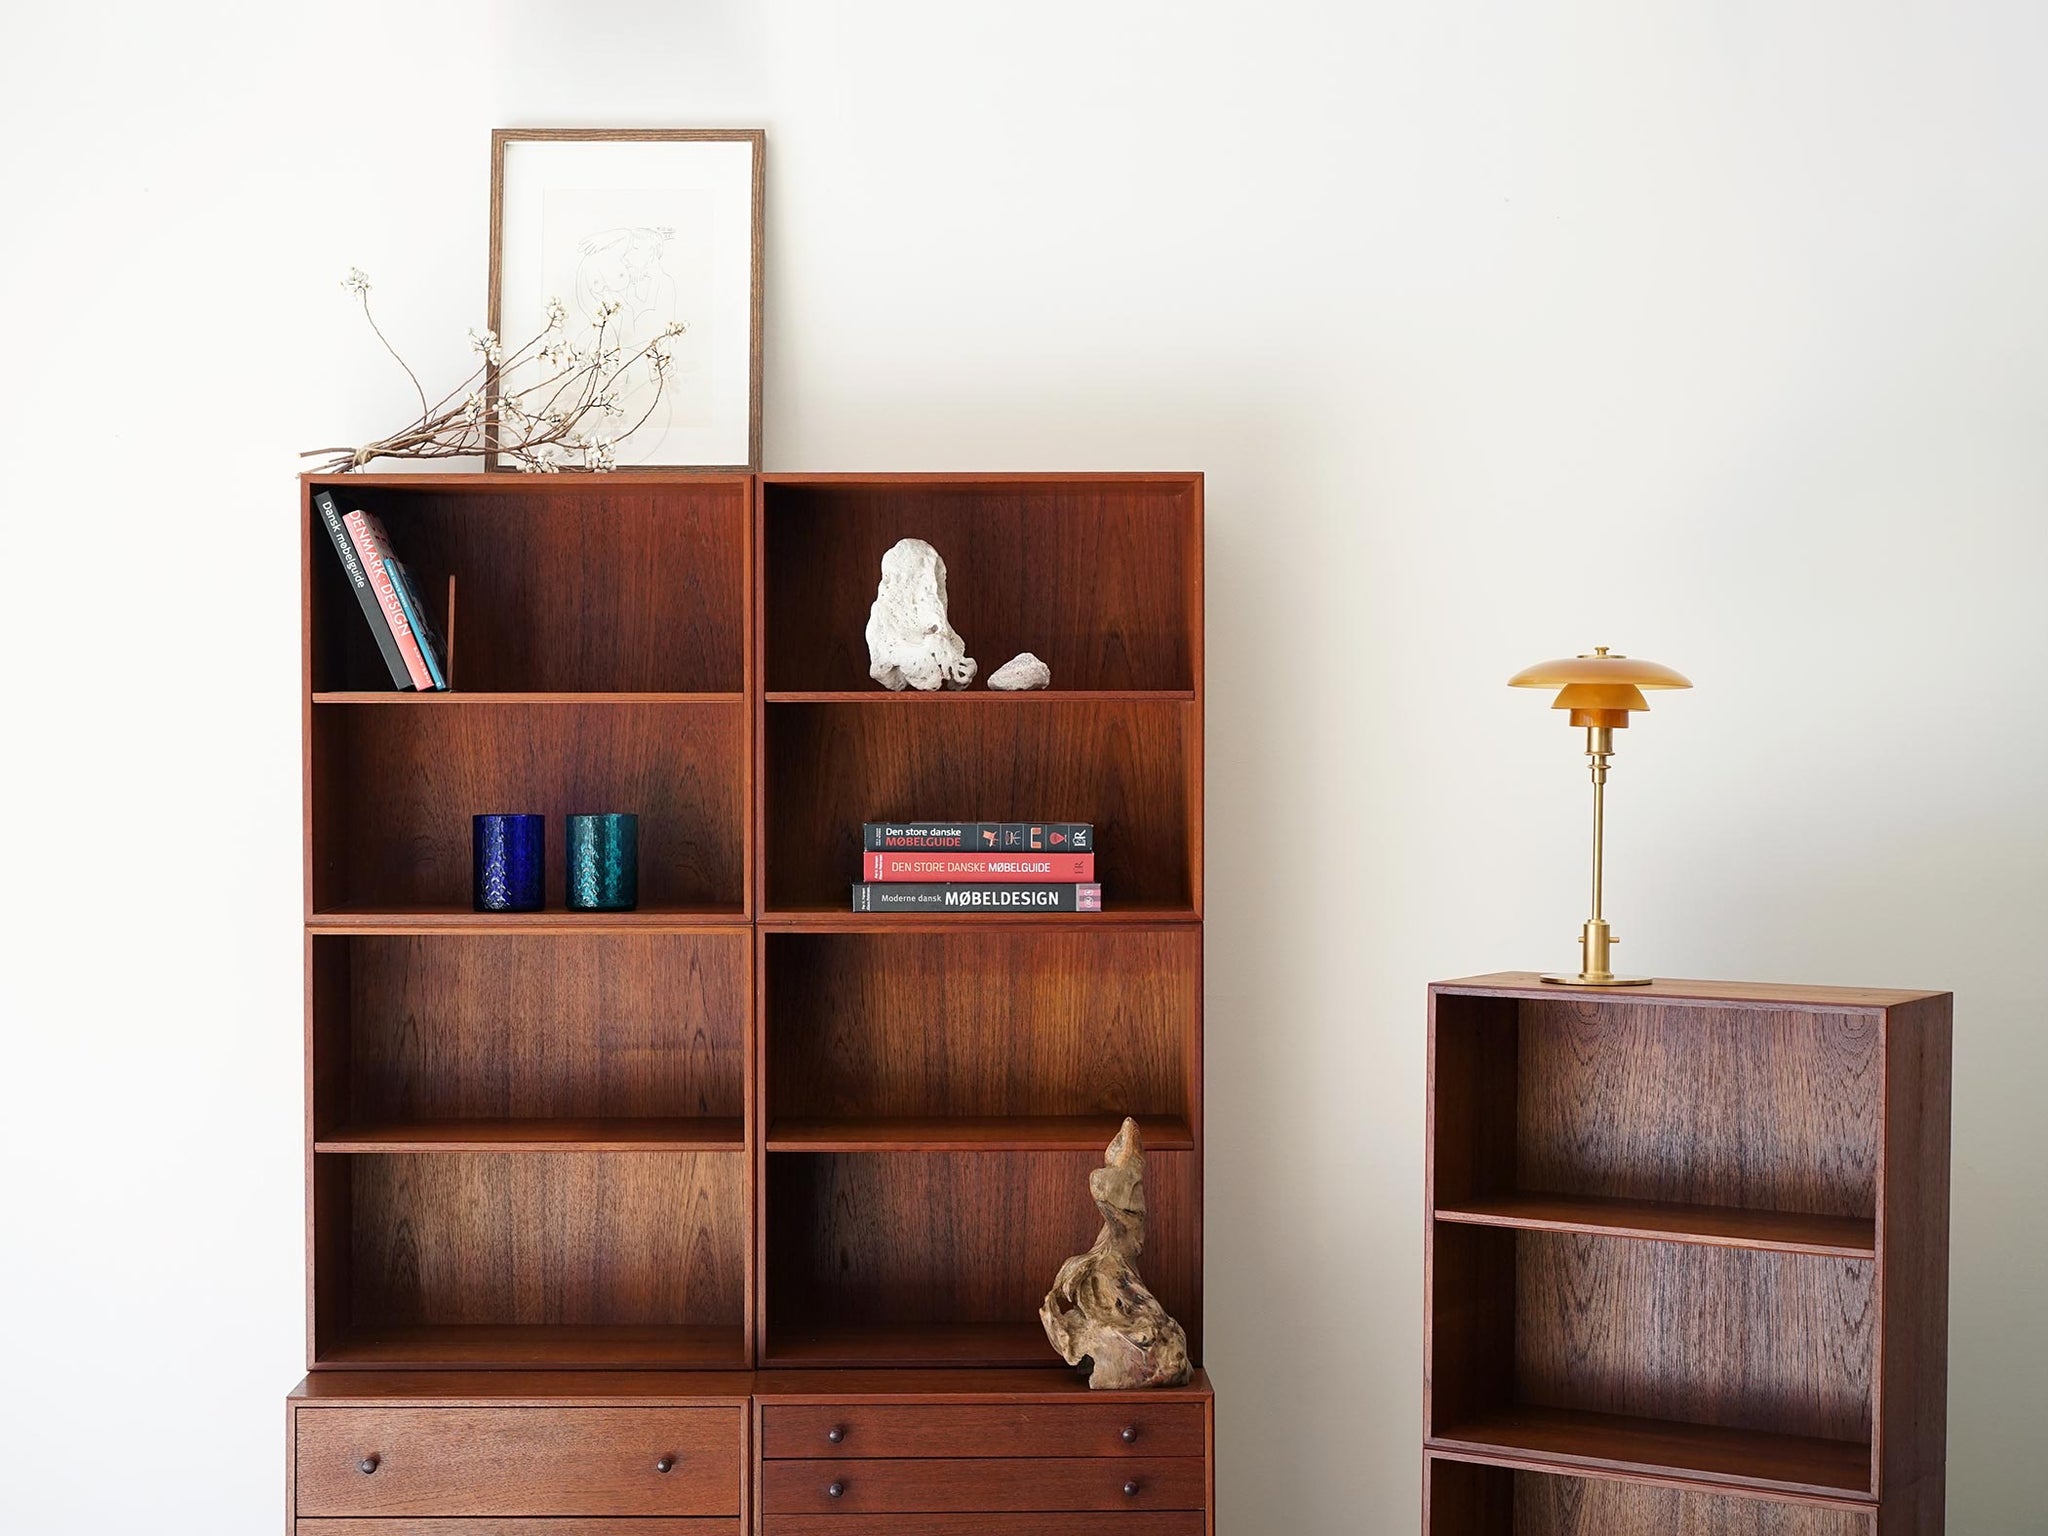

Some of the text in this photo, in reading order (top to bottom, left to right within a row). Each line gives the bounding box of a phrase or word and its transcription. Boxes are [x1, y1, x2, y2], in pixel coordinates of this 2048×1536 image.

[322, 501, 365, 588] Dansk møbelguide
[381, 584, 411, 637] DESIGN
[886, 827, 961, 836] Den store danske
[885, 837, 961, 847] MØBELGUIDE
[891, 862, 1051, 873] DEN STORE DANSKE MØBELGUIDE
[881, 891, 1059, 907] Moderne dansk MØBELDESIGN
